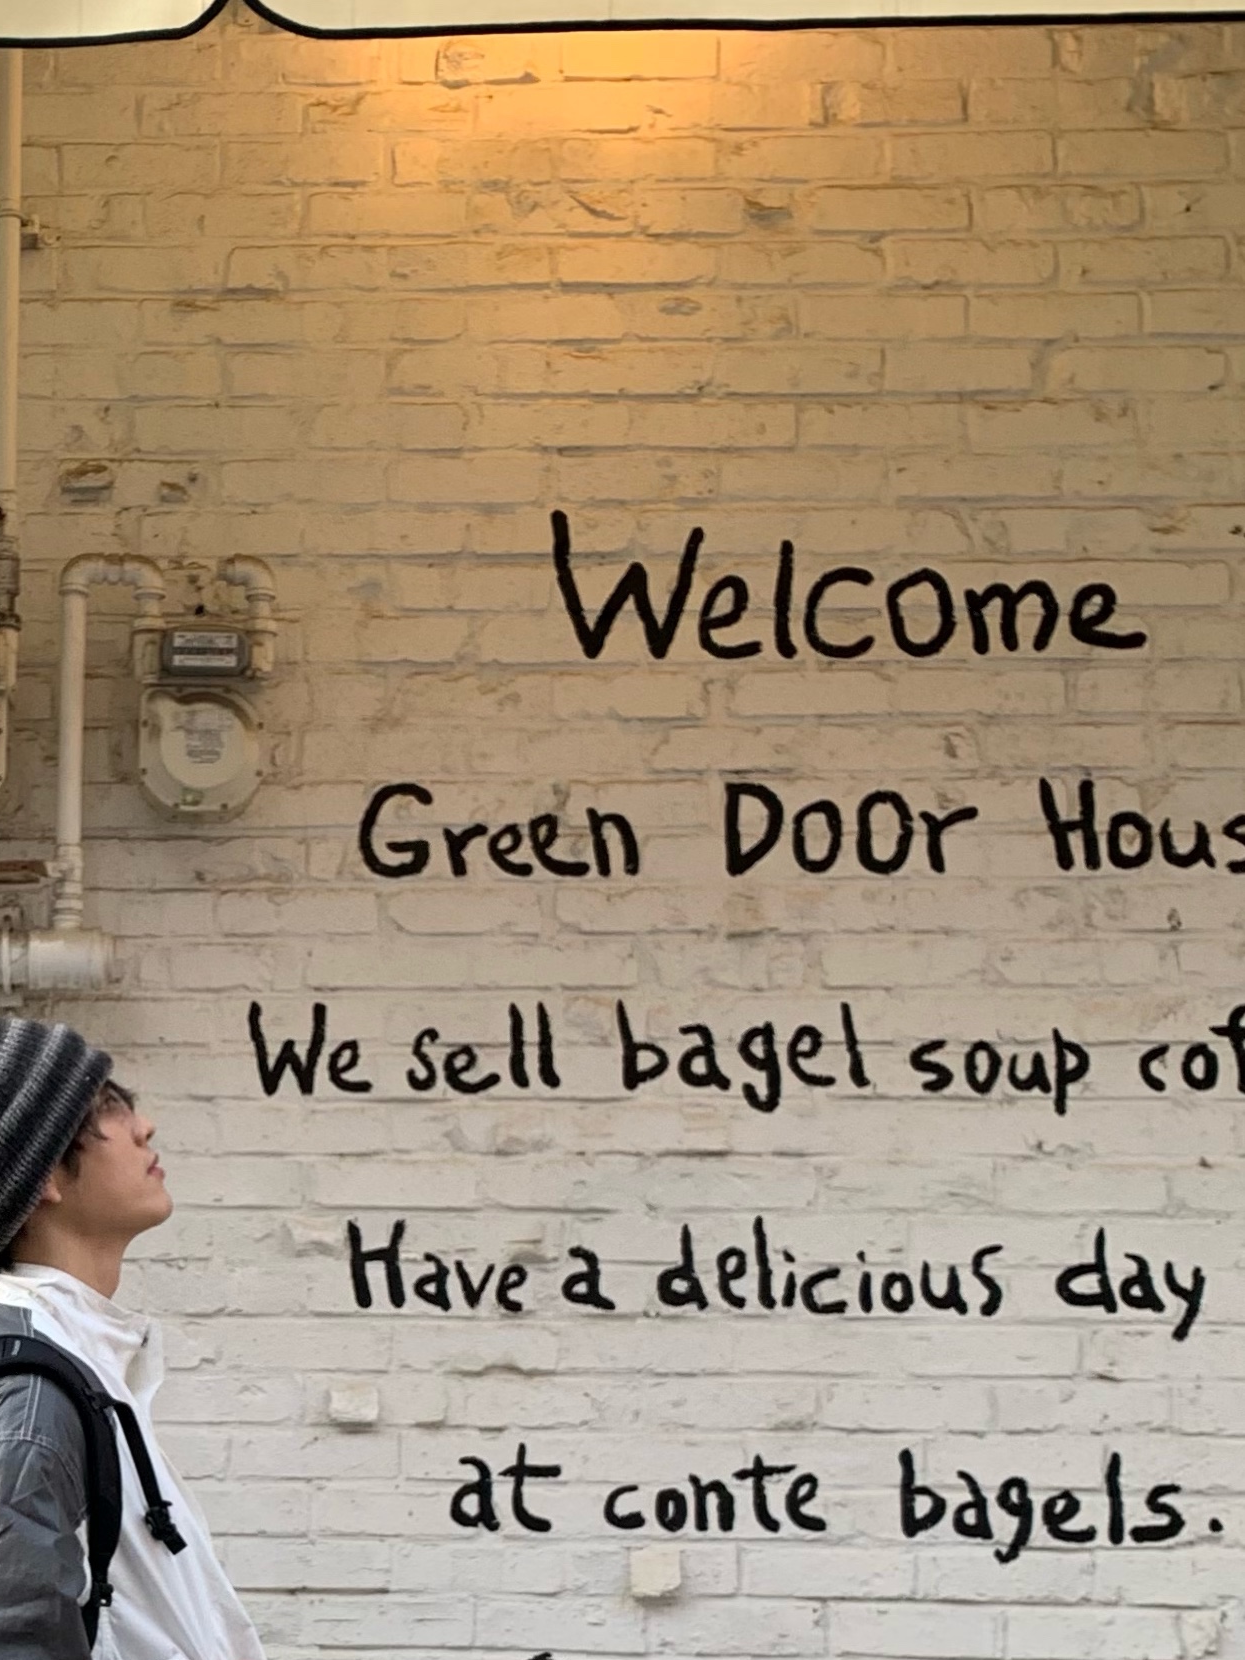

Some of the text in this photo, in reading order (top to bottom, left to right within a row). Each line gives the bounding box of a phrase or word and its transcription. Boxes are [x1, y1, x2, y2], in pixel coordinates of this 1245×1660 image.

[551, 510, 1146, 659] Welcome
[359, 783, 639, 878] Green
[249, 1002, 372, 1095] We
[408, 1003, 560, 1093] sell
[617, 1001, 870, 1112] bagel
[910, 1029, 1089, 1115] soup
[348, 1217, 1204, 1341] Have a delicious day
[451, 1444, 1222, 1563] at conte bagels.
